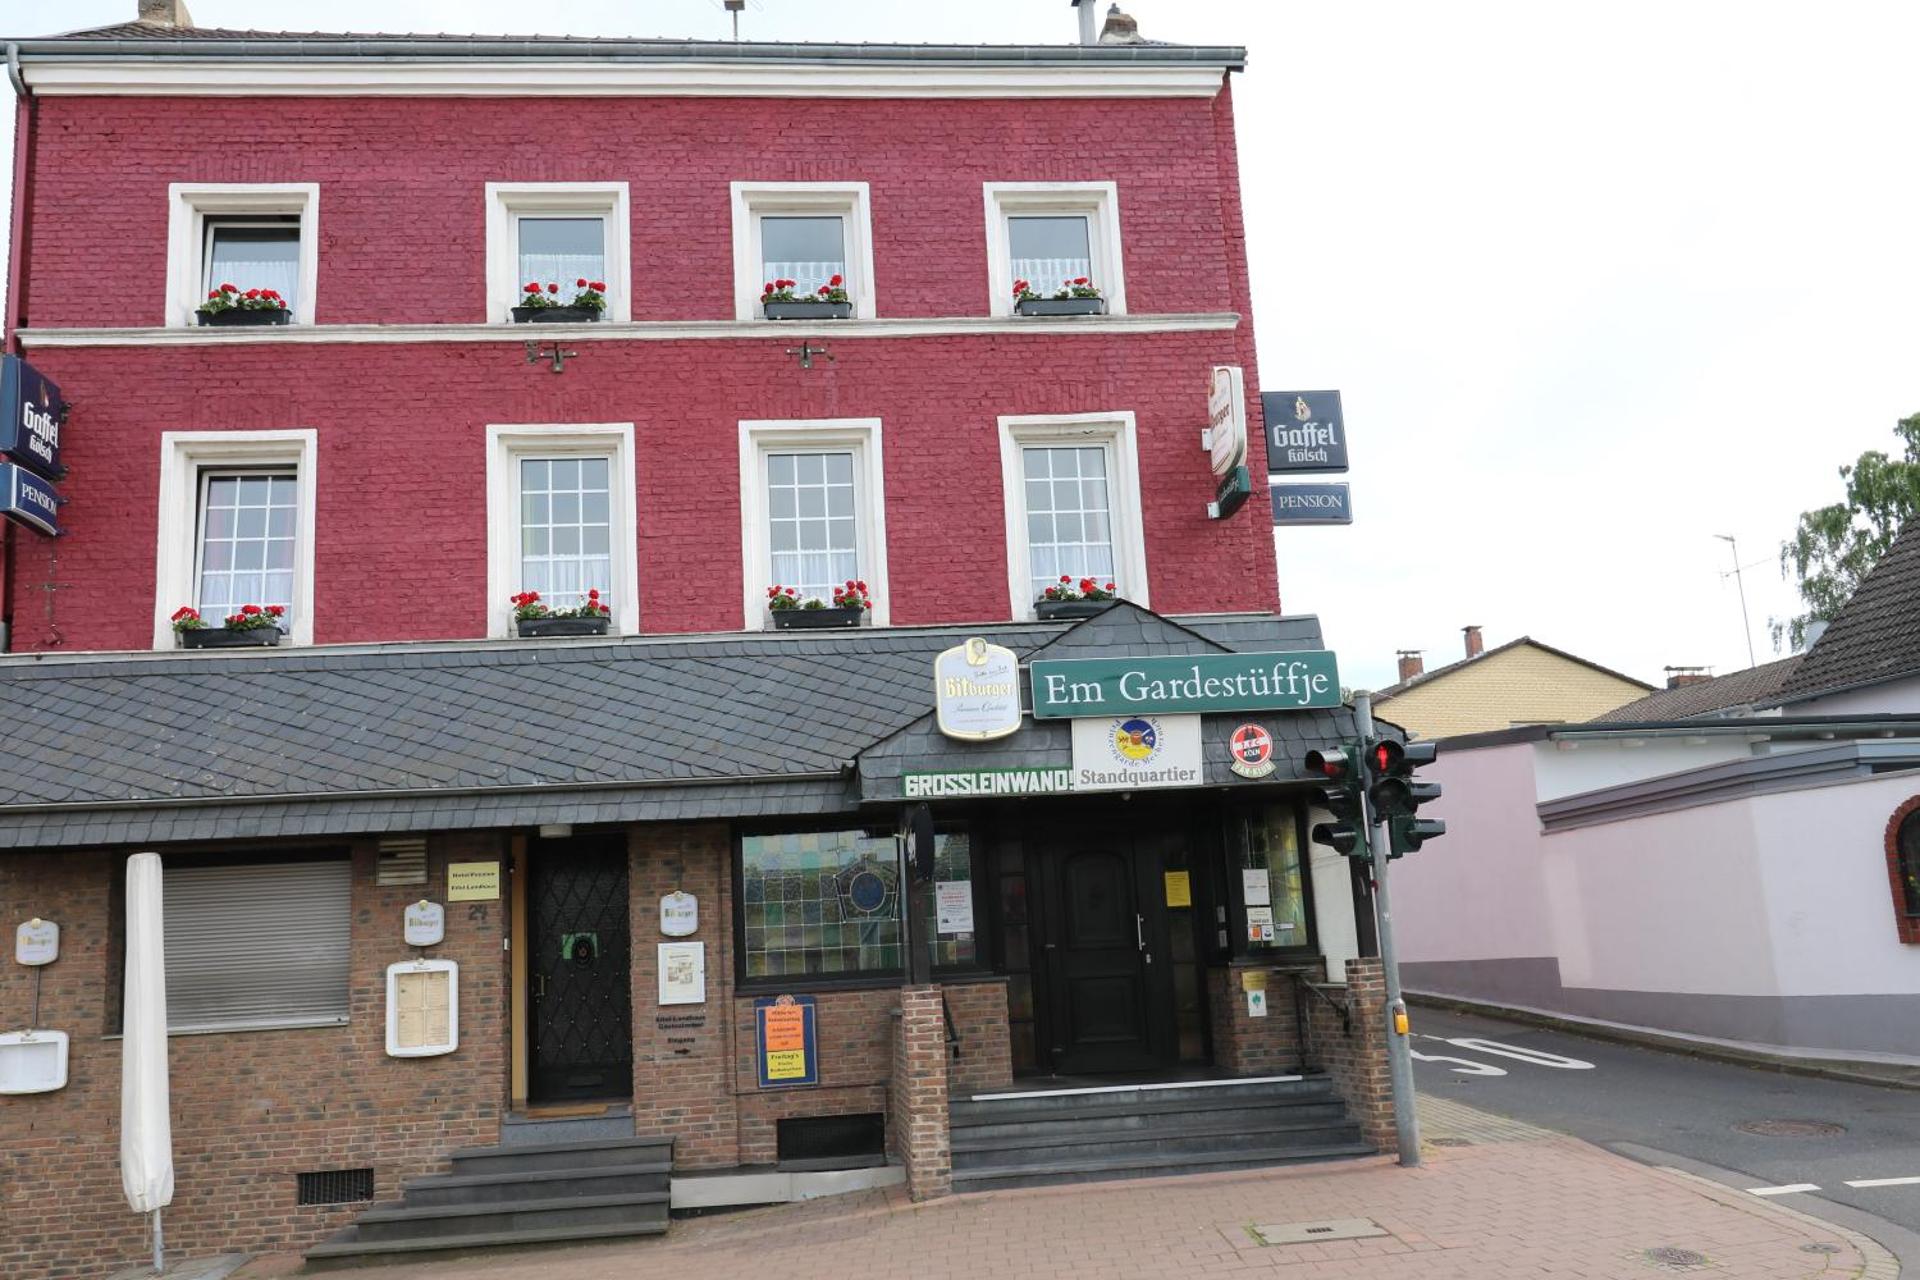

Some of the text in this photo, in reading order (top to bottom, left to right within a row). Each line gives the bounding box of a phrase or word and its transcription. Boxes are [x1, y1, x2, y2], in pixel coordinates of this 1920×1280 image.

[24, 401, 59, 449] Gaffel
[1273, 422, 1339, 448] Gaffel
[1288, 448, 1328, 463] Kölsch
[22, 483, 57, 515] PENSION
[1280, 494, 1343, 508] PENSION
[945, 675, 1016, 698] Bitburger
[1044, 661, 1329, 705] Em Gardestüffje
[1243, 748, 1261, 758] KÖLN
[905, 769, 1074, 797] GROSSLEINWAND!
[1080, 766, 1196, 786] Standquartier
